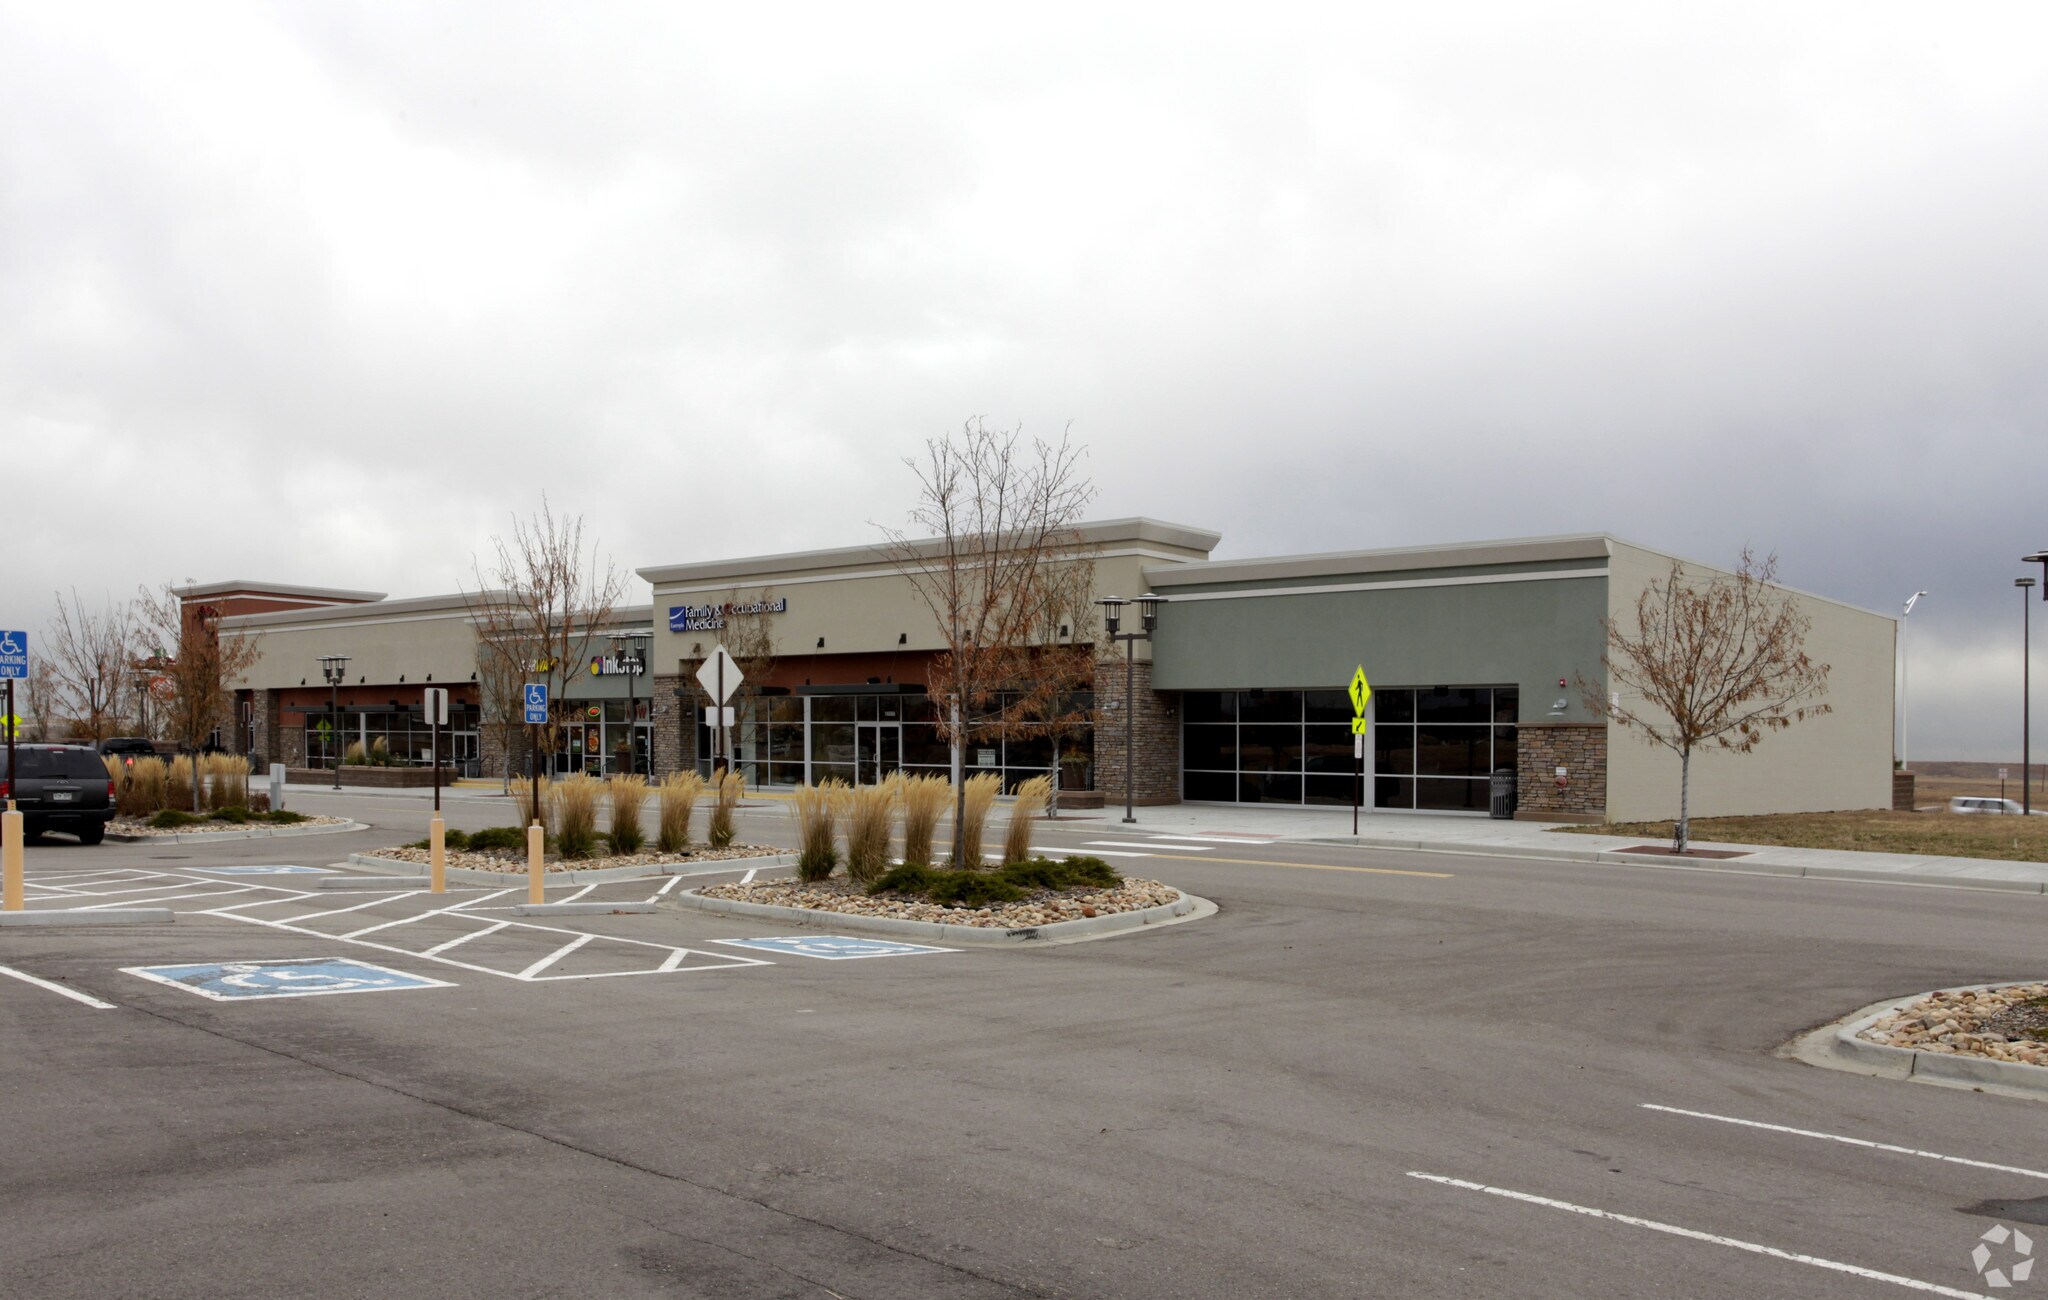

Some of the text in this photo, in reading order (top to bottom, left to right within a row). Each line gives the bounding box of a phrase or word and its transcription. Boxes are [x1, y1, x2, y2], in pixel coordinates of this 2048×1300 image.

[685, 605, 713, 619] Family
[715, 604, 722, 615] &
[685, 618, 724, 630] Medicine
[0, 655, 26, 665] ARKING
[1, 666, 21, 676] ONLY
[526, 704, 546, 712] PARKING
